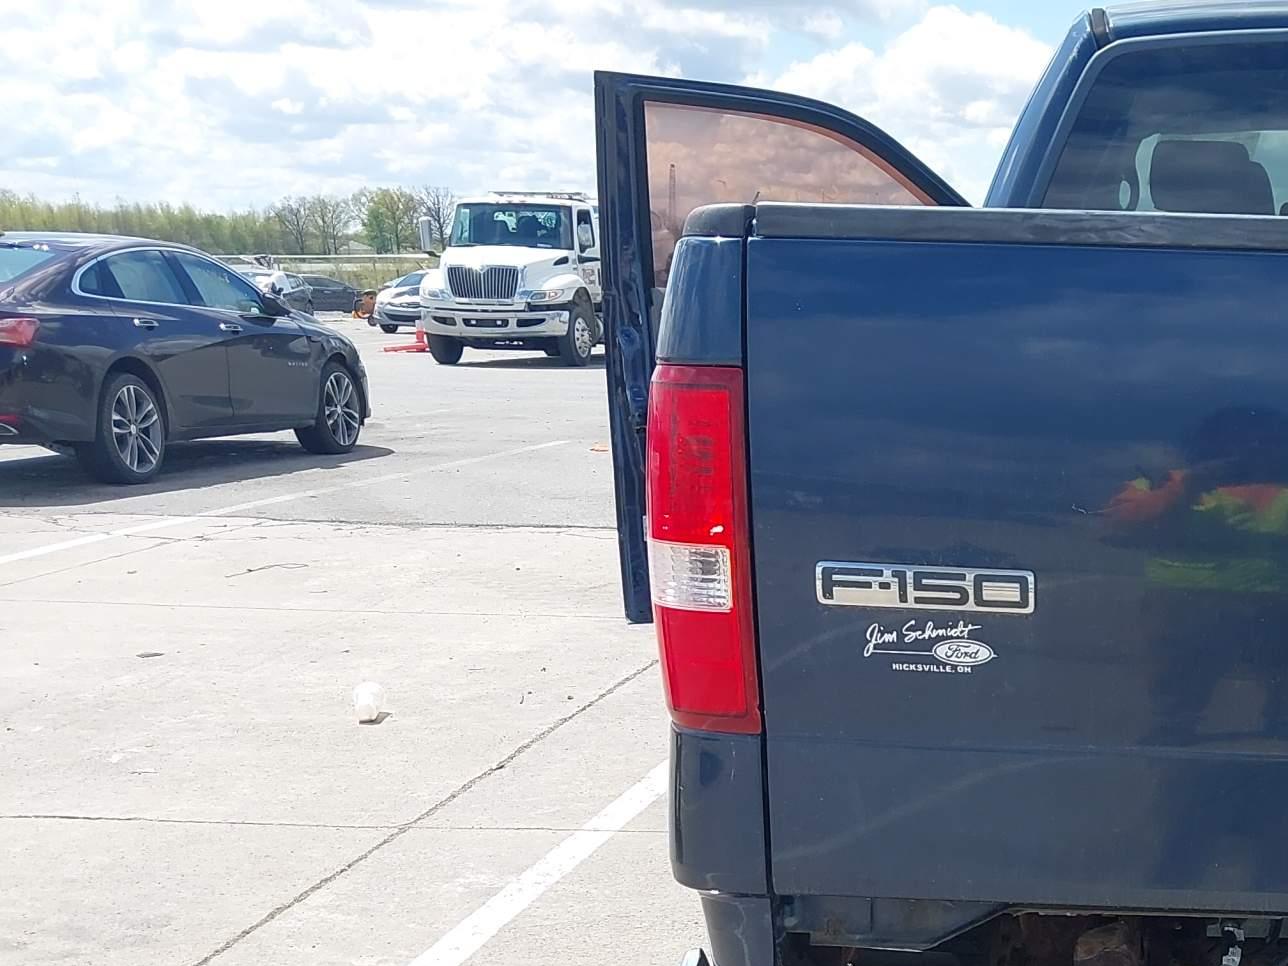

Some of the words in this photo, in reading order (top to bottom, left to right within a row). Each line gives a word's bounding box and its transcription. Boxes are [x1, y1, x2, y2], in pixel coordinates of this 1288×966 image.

[818, 564, 1032, 611] F-150
[863, 623, 897, 657] Jim
[902, 619, 983, 643] Schmidt
[944, 643, 981, 660] Ford
[892, 663, 955, 673] HICKSVILLE,
[957, 665, 972, 673] OH
